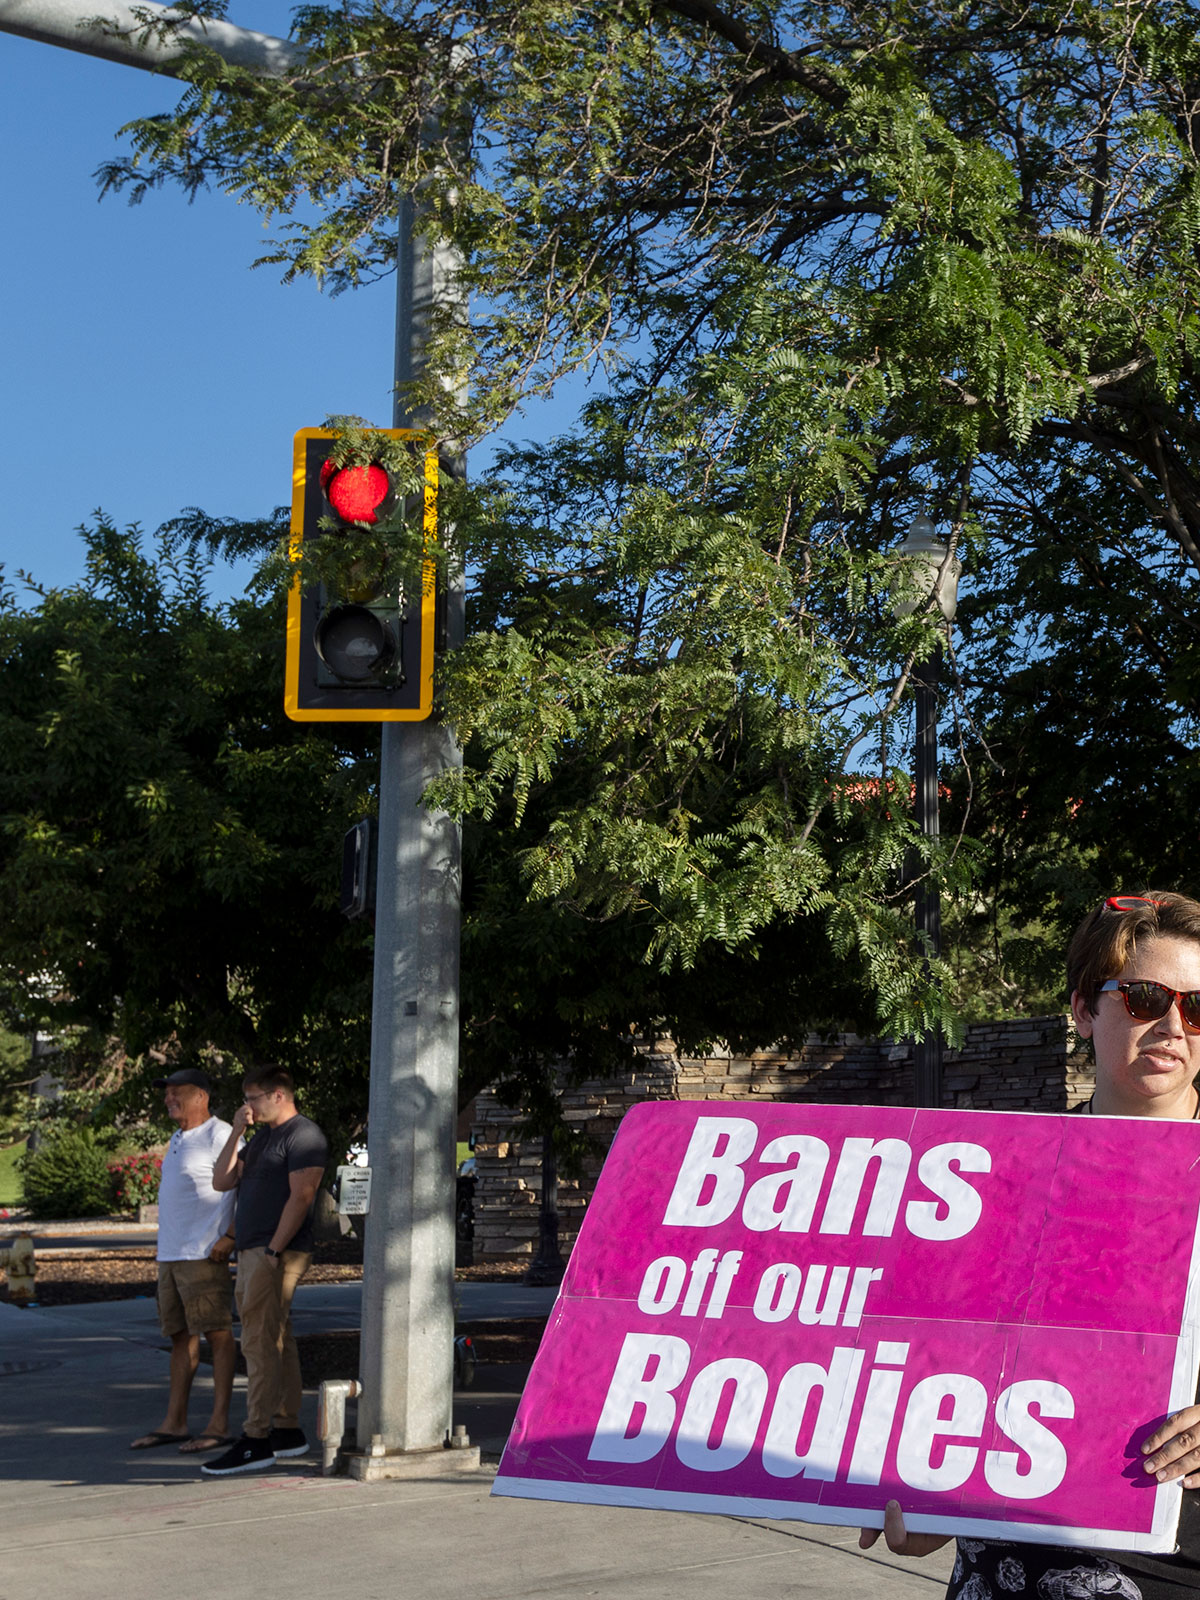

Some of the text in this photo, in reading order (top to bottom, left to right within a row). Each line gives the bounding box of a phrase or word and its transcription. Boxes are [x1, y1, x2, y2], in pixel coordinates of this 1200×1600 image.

[662, 1114, 993, 1243] Bans
[636, 1248, 884, 1328] off our
[587, 1332, 1075, 1500] Bodies
